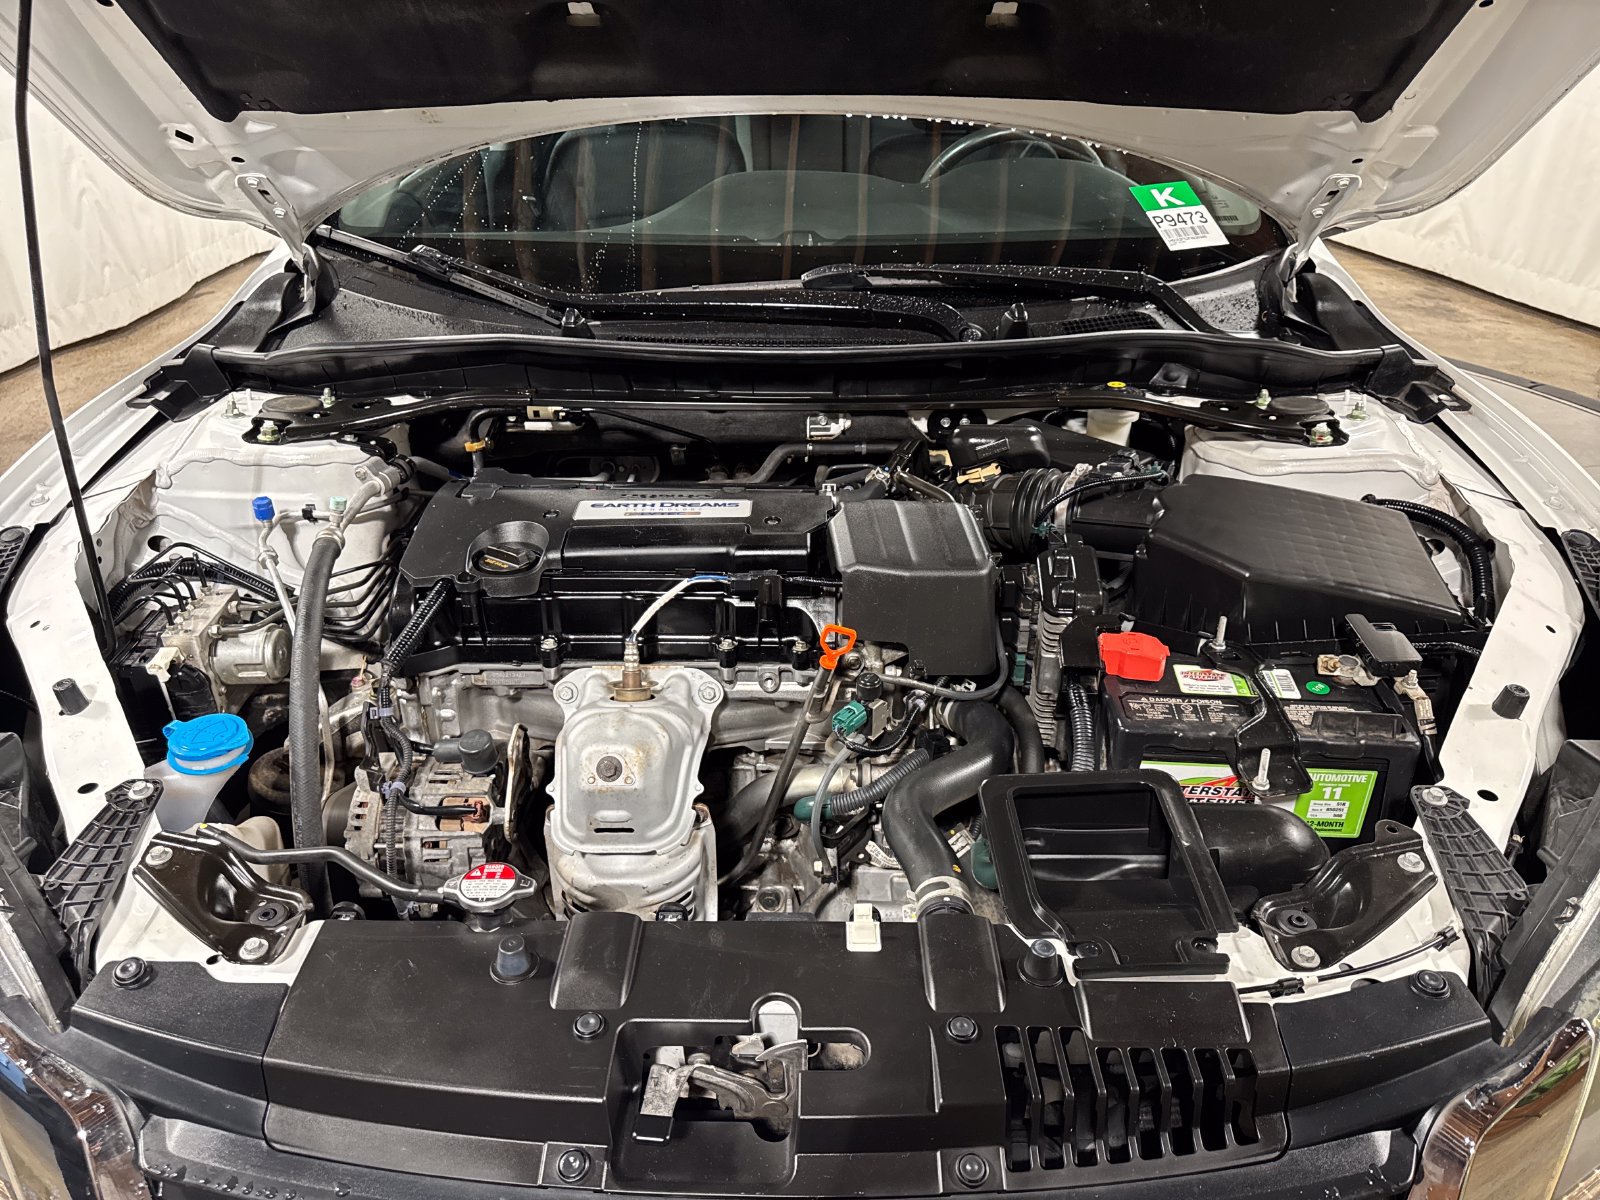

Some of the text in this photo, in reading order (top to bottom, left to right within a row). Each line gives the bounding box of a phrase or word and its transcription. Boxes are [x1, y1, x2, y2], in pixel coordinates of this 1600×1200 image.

[1150, 187, 1185, 207] K
[1152, 211, 1208, 228] P9473
[1322, 787, 1342, 799] 11
